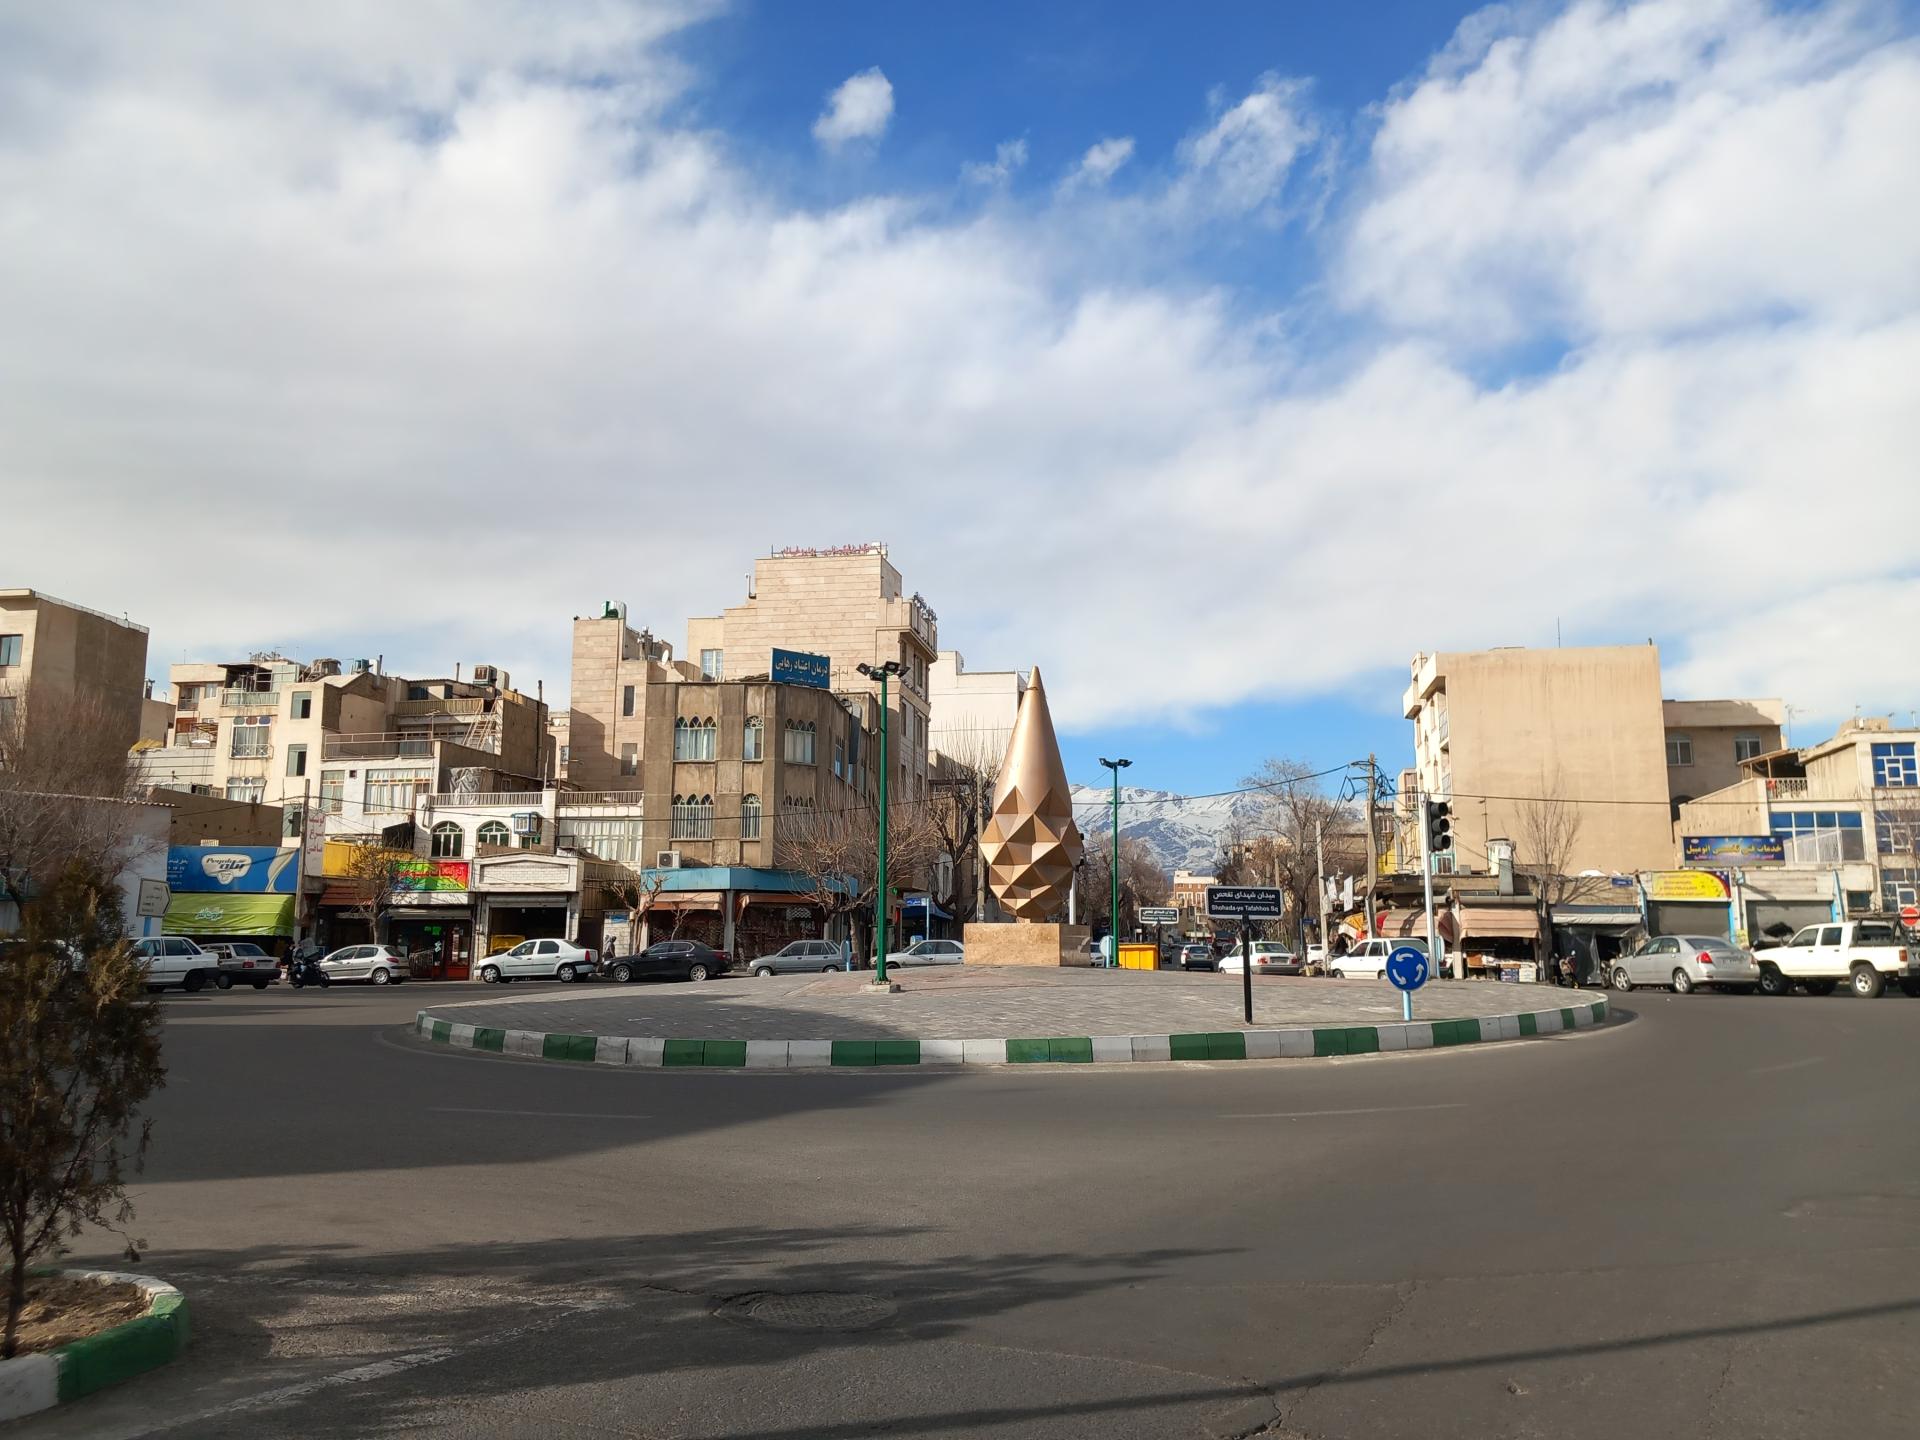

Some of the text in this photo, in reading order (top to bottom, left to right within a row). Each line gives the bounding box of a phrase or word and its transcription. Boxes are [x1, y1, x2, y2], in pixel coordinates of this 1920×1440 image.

[793, 658, 811, 674] اعتیاد
[811, 661, 828, 677] درمان
[1212, 891, 1275, 900] میدان شهدای تفحص
